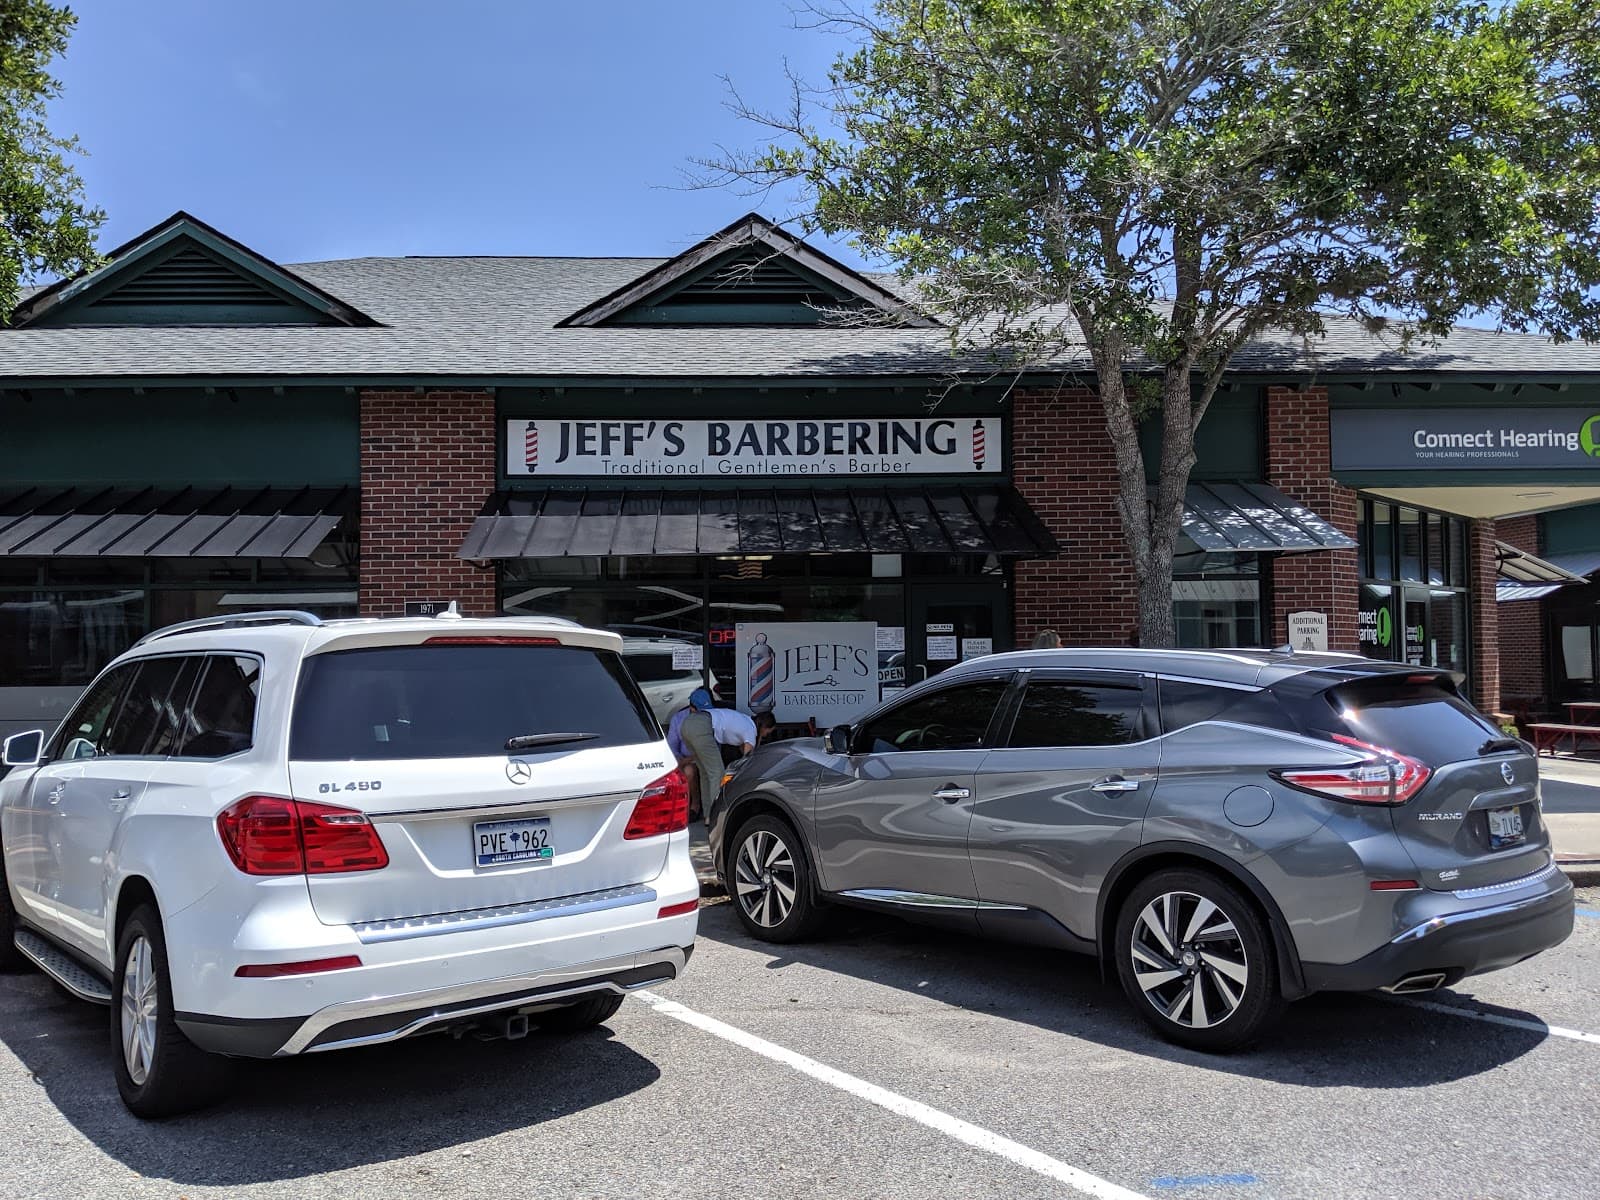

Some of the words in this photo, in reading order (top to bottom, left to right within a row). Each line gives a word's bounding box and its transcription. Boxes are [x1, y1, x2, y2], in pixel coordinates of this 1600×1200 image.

[555, 421, 685, 463] JEFF'S
[707, 420, 957, 457] BARBERING
[1414, 430, 1494, 448] Connect
[1500, 430, 1579, 450] Hearing
[602, 460, 705, 474] Traditional
[718, 459, 836, 474] Gentlemen's
[849, 458, 911, 473] Barber
[420, 604, 434, 614] 1971
[1358, 609, 1377, 624] nnect
[709, 630, 736, 644] OP
[1358, 626, 1377, 645] aring
[779, 644, 868, 682] JEFF'S
[877, 668, 904, 681] OPEN
[783, 694, 865, 706] BARBERSHOP
[480, 833, 507, 854] PVE
[522, 829, 549, 849] 962
